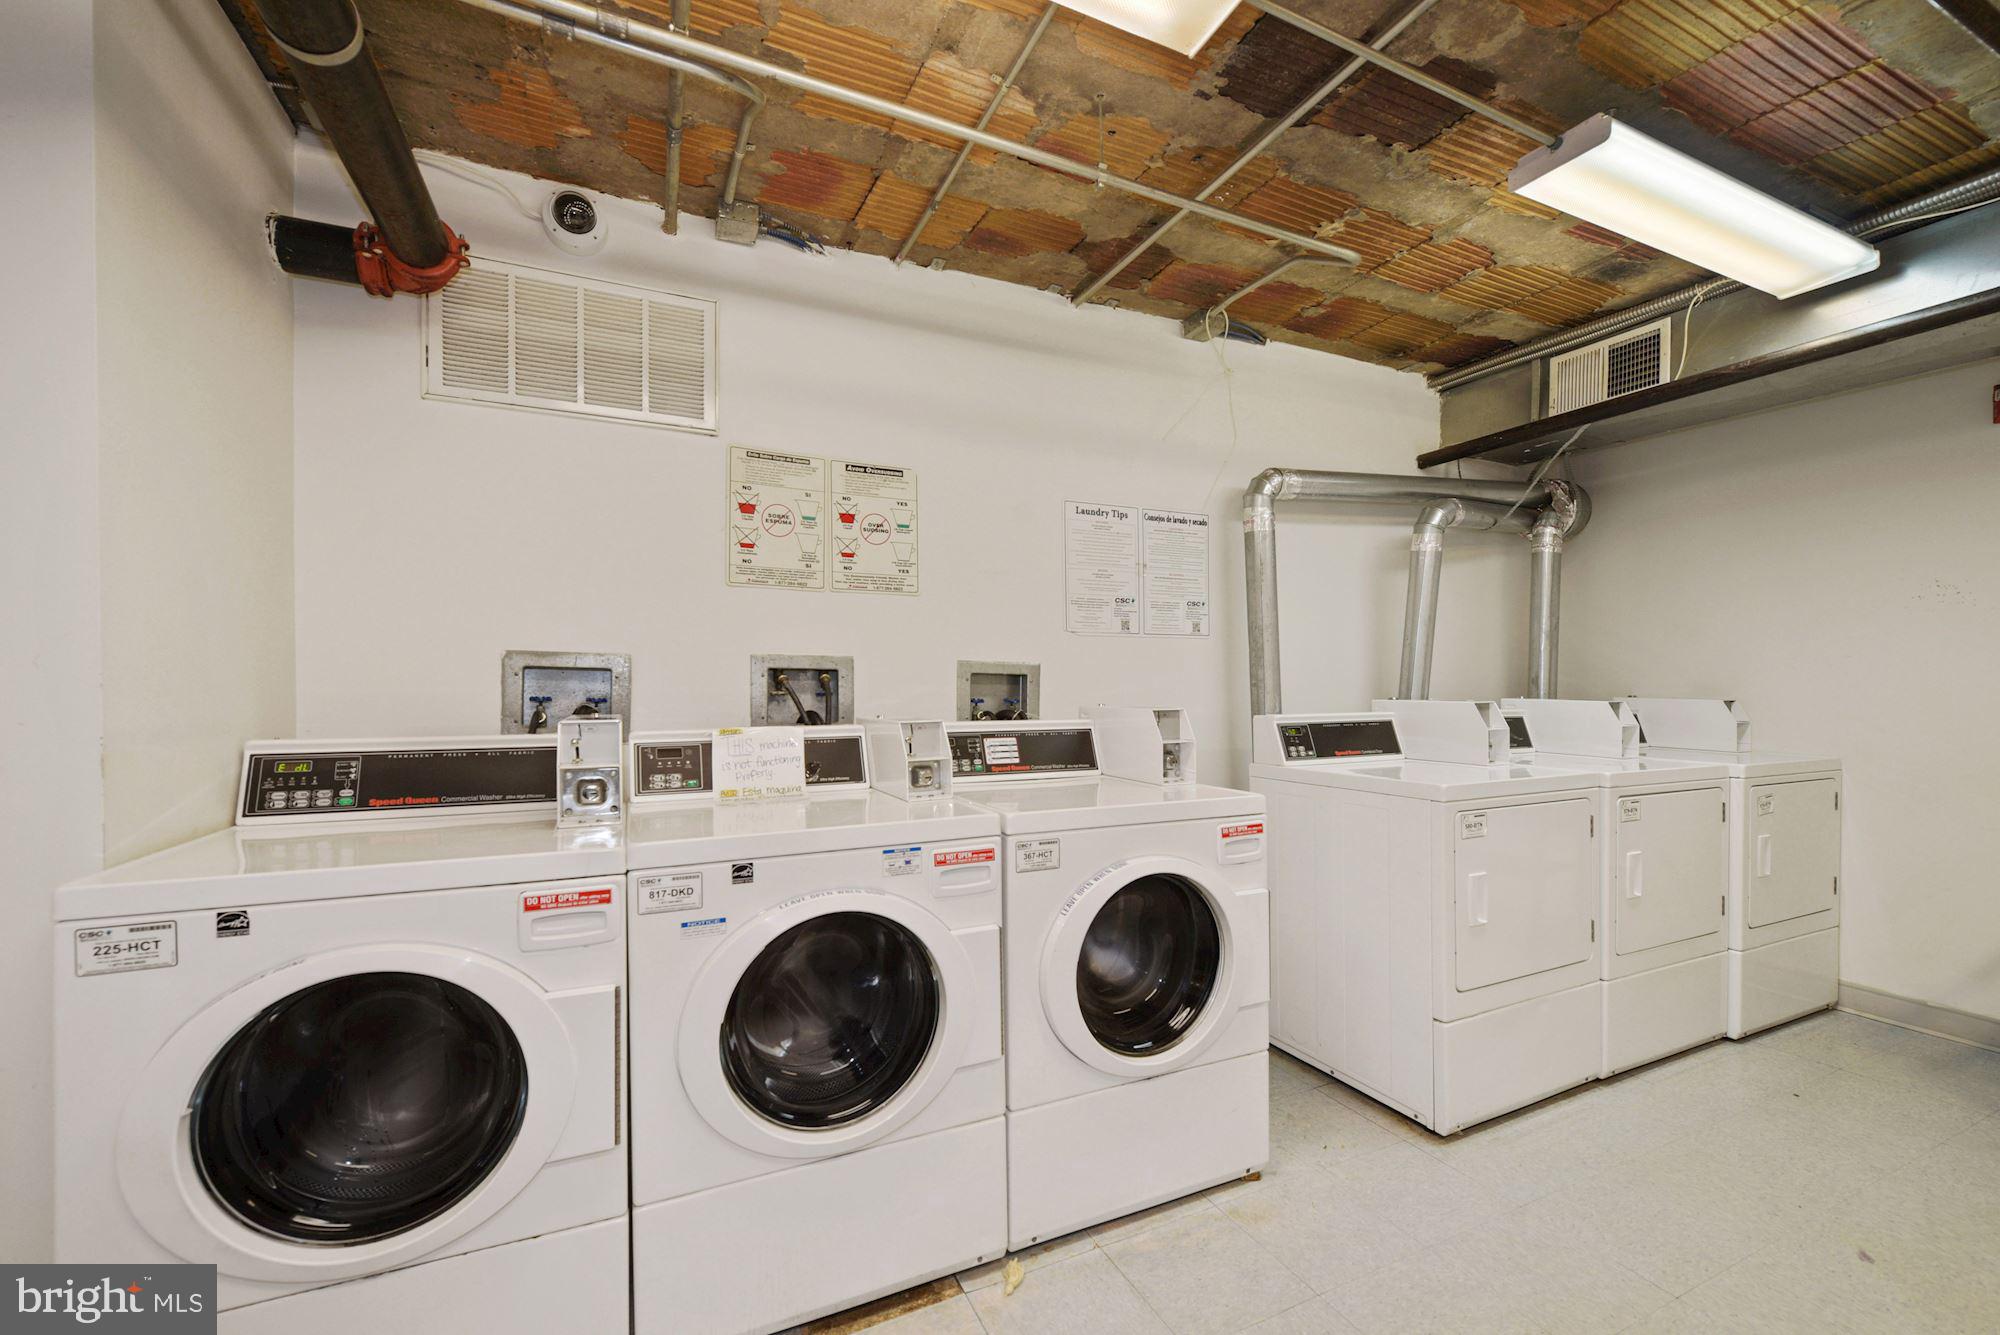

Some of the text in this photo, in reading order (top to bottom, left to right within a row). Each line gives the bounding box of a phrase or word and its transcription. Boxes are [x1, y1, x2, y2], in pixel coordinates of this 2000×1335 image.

[1076, 506, 1128, 520] Laundry Tips
[1144, 513, 1165, 522] Consejos
[1173, 516, 1188, 525] lavado
[1192, 518, 1207, 526] secado
[734, 760, 753, 770] not
[755, 756, 801, 771] functioning
[369, 797, 403, 807] Speed
[405, 796, 439, 805] Queen
[1024, 850, 1052, 860] 367-HCT
[526, 897, 538, 905] DO
[540, 895, 556, 904] NOT
[558, 894, 579, 903] OPEN
[649, 888, 694, 899] 817-DKD
[1060, 897, 1078, 916] LEAVE
[1077, 882, 1093, 896] OPEN
[93, 940, 162, 956] 225-HCT
